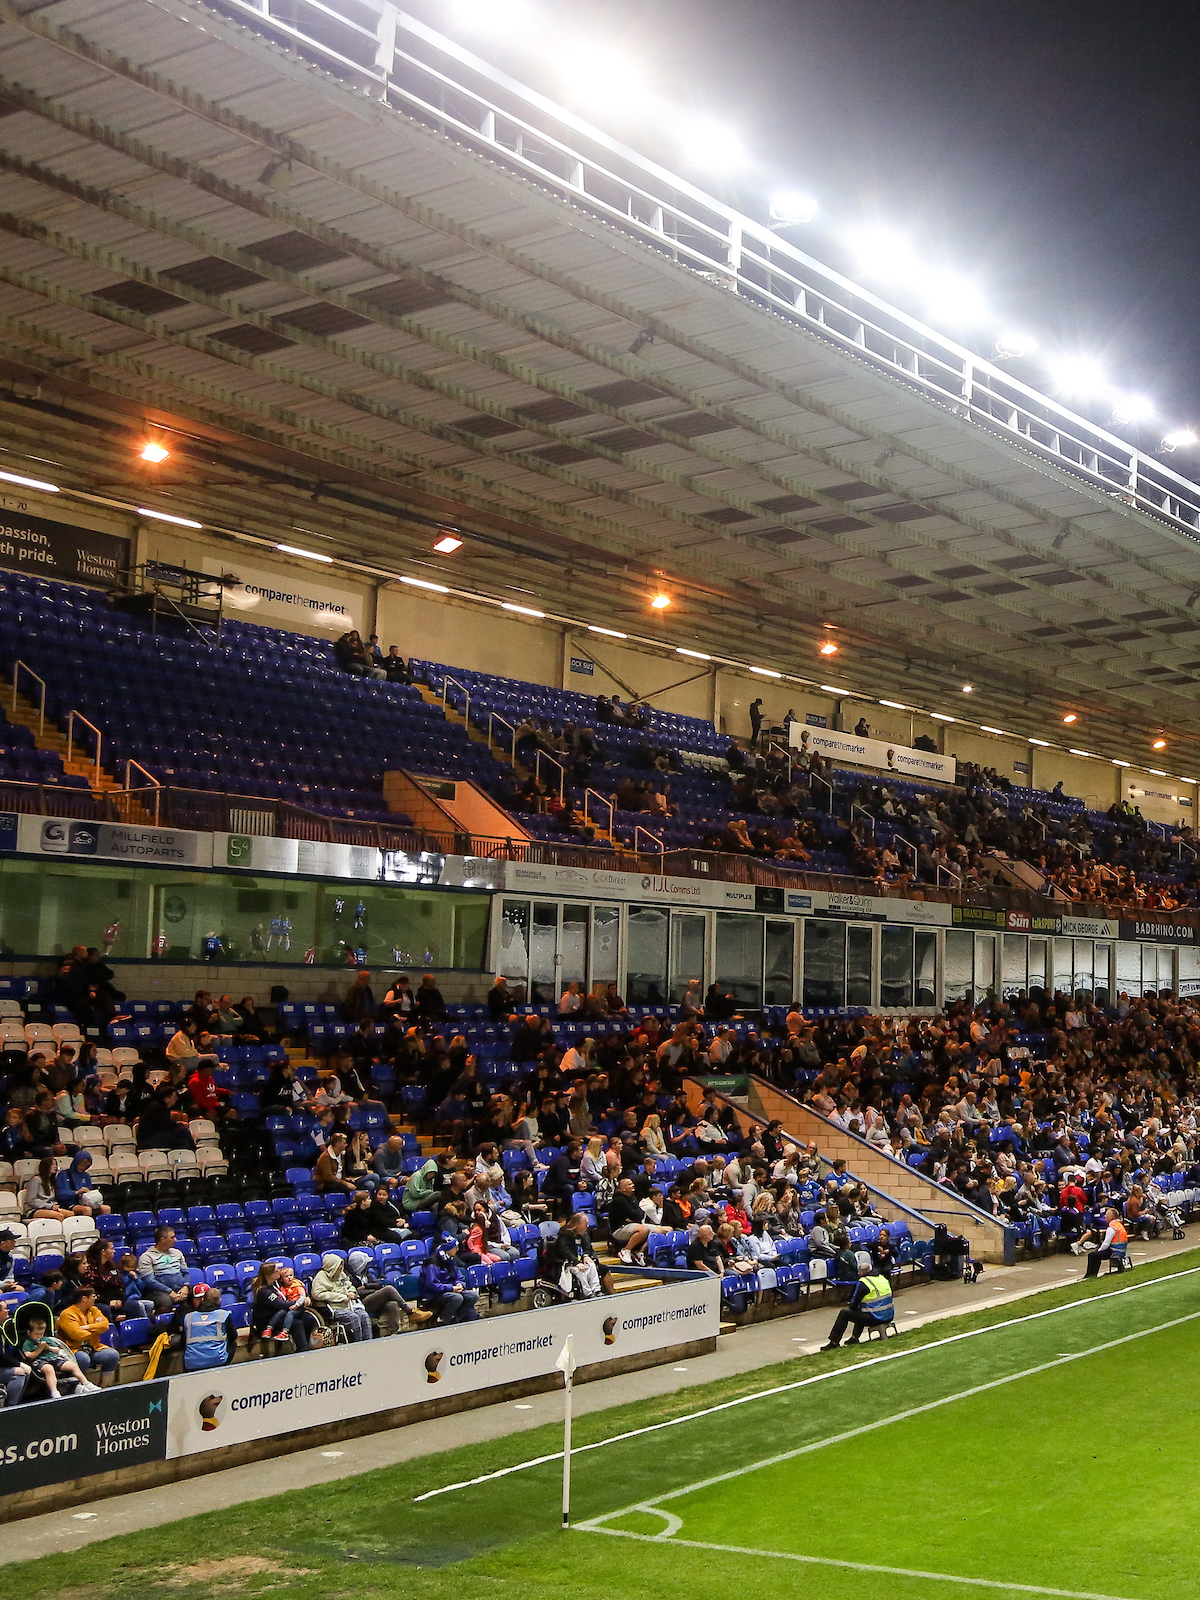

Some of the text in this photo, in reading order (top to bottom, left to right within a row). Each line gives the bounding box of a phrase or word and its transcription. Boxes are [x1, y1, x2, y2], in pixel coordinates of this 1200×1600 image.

[19, 547, 57, 566] pride.
[76, 548, 117, 568] Weston
[76, 561, 117, 579] Homes
[244, 583, 347, 616] comparethemarket
[812, 736, 866, 755] comparethemarket
[111, 830, 175, 845] MILLFIELD
[111, 843, 185, 858] AUTOPARTS
[725, 892, 753, 901] MULTIPLEX
[1008, 912, 1030, 929] Sun
[1062, 921, 1099, 935] MICK GEORGE
[1135, 922, 1194, 939] BADRHINO.COM
[620, 1303, 706, 1330] comparethemarket
[449, 1334, 553, 1366] comparethemarket
[231, 1371, 362, 1411] comparethemarket
[95, 1417, 150, 1439] Weston
[0, 1433, 78, 1466] es.com
[95, 1434, 150, 1457] Homes
